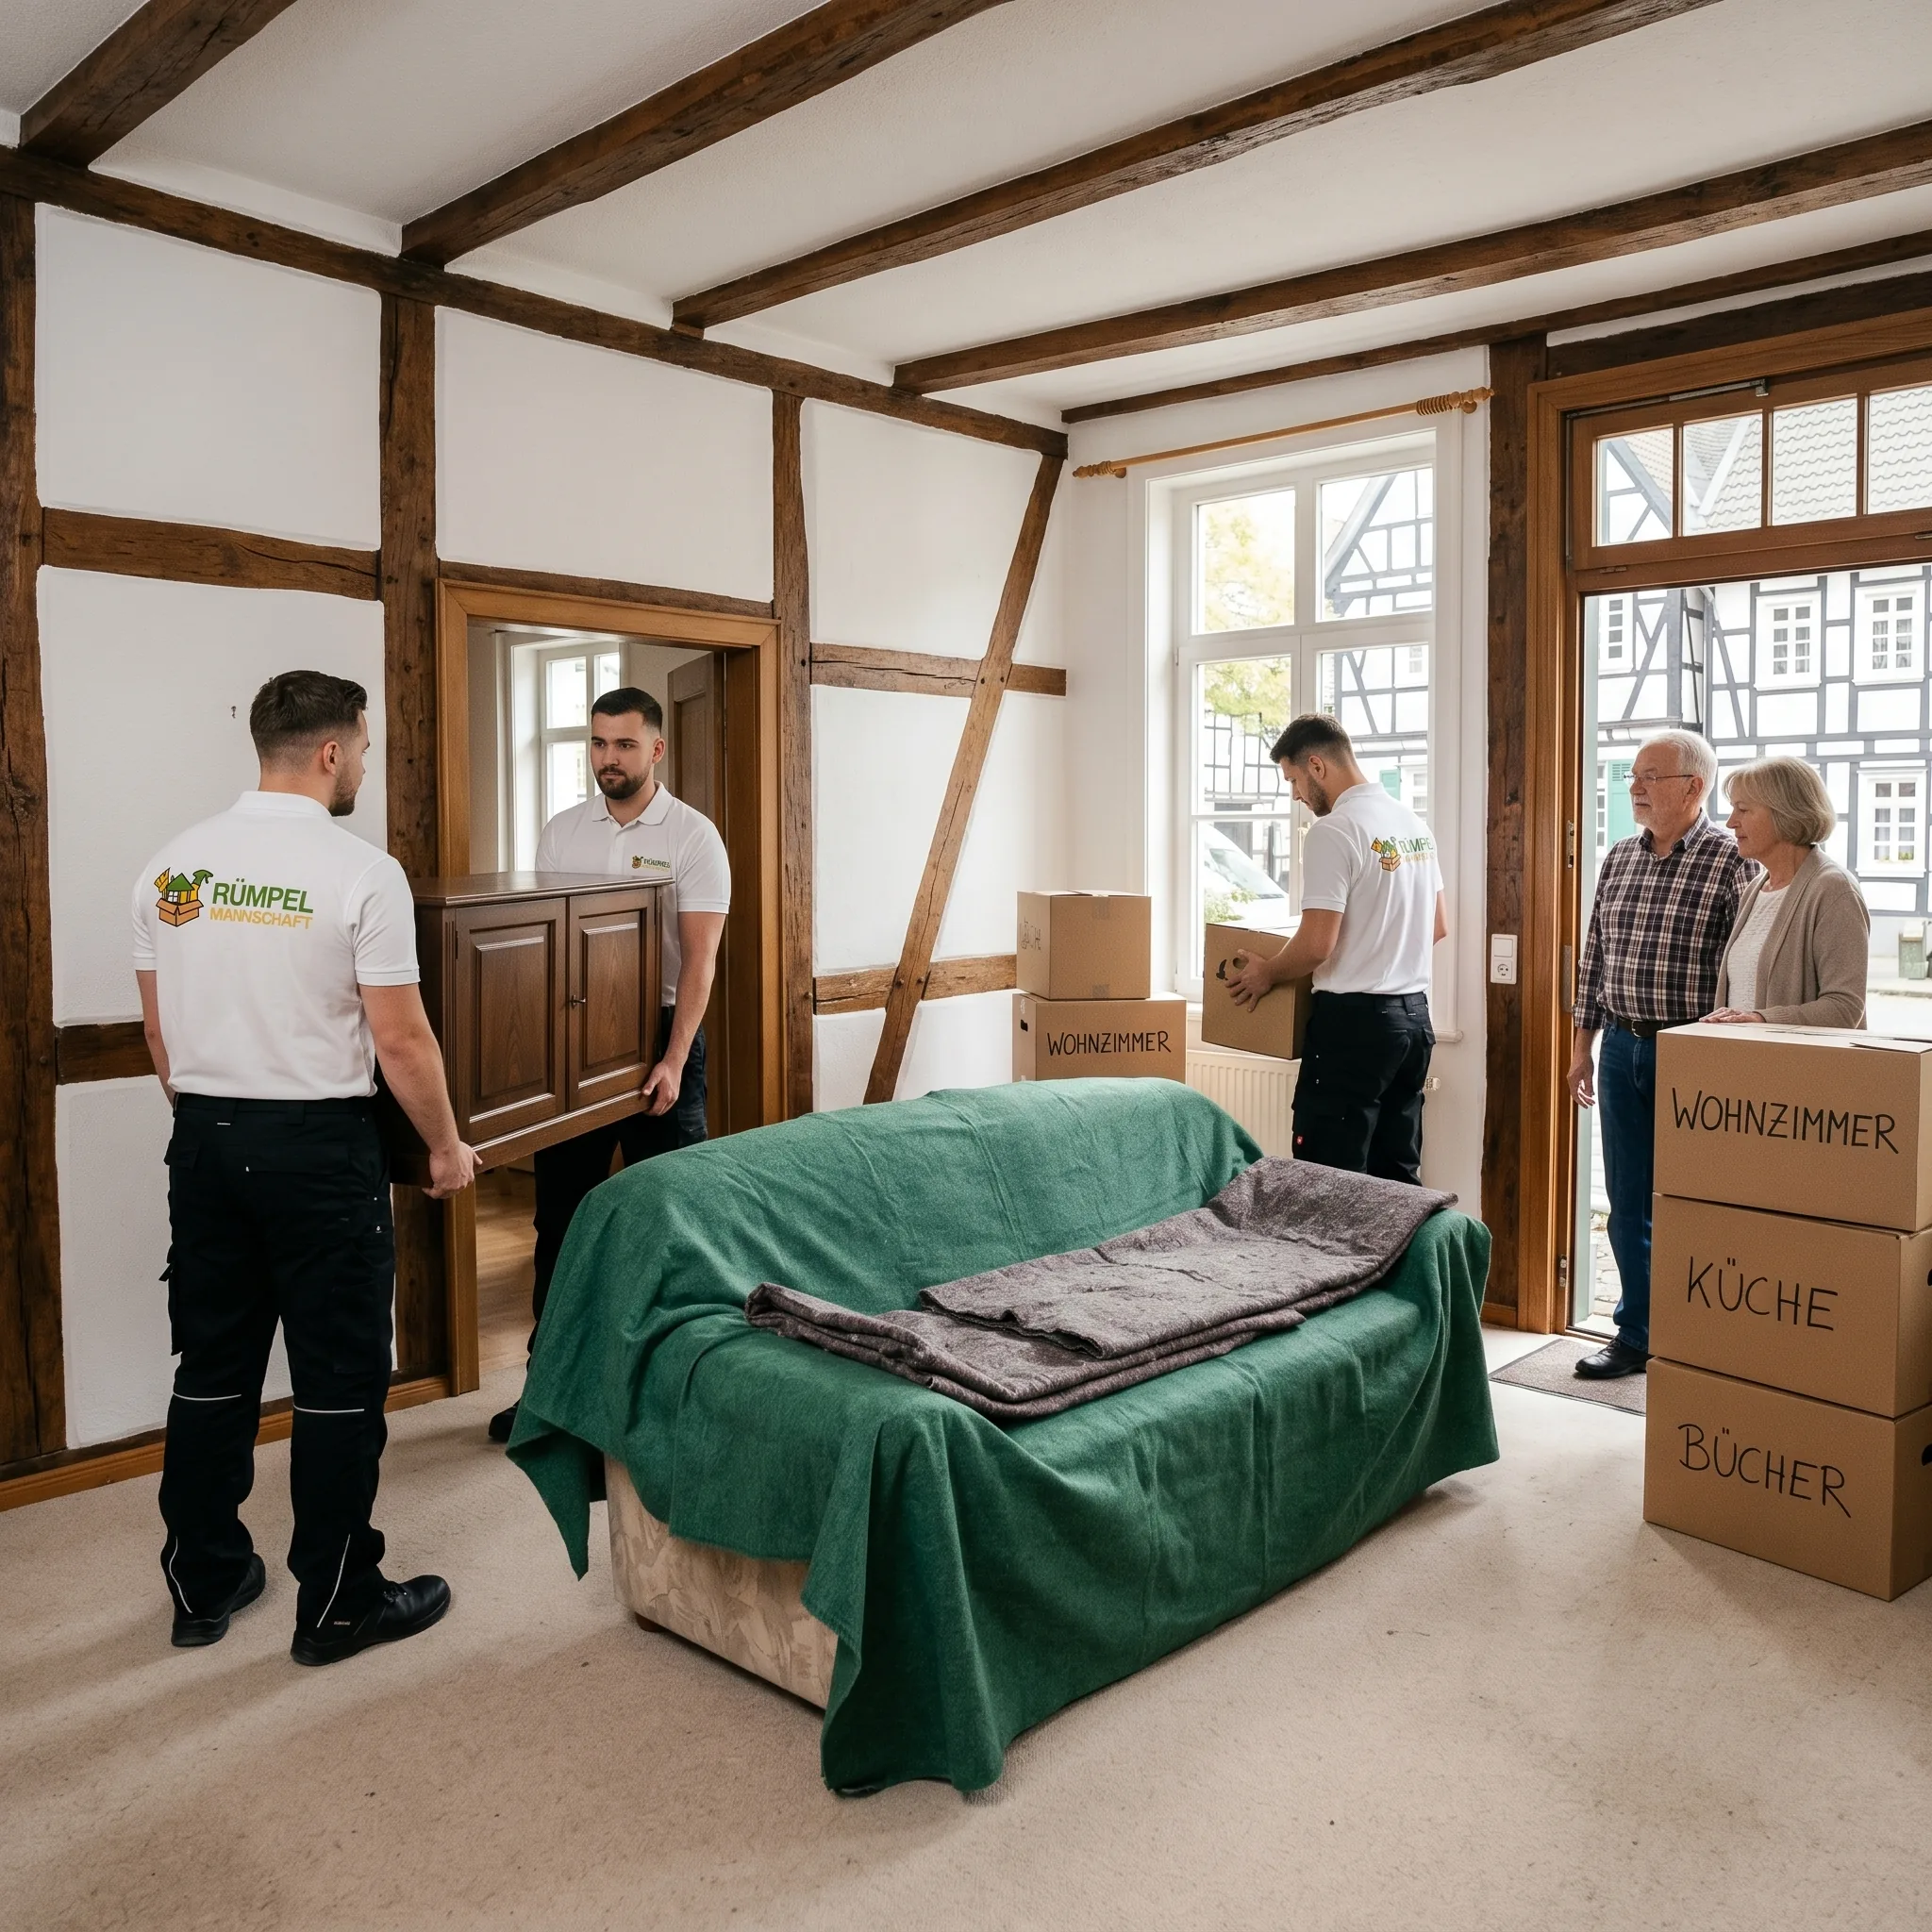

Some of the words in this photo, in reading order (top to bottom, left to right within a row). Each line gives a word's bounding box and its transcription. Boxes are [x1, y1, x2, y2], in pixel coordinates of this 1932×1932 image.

[210, 908, 313, 929] MANNSCHAFT
[213, 878, 313, 913] RÜMPEL
[1047, 1031, 1172, 1056] WOHNZIMMER
[1672, 1087, 1899, 1154] WOHNZIMMER
[1688, 1256, 1839, 1331] KÜCHE
[1677, 1424, 1852, 1518] BÜCHER
